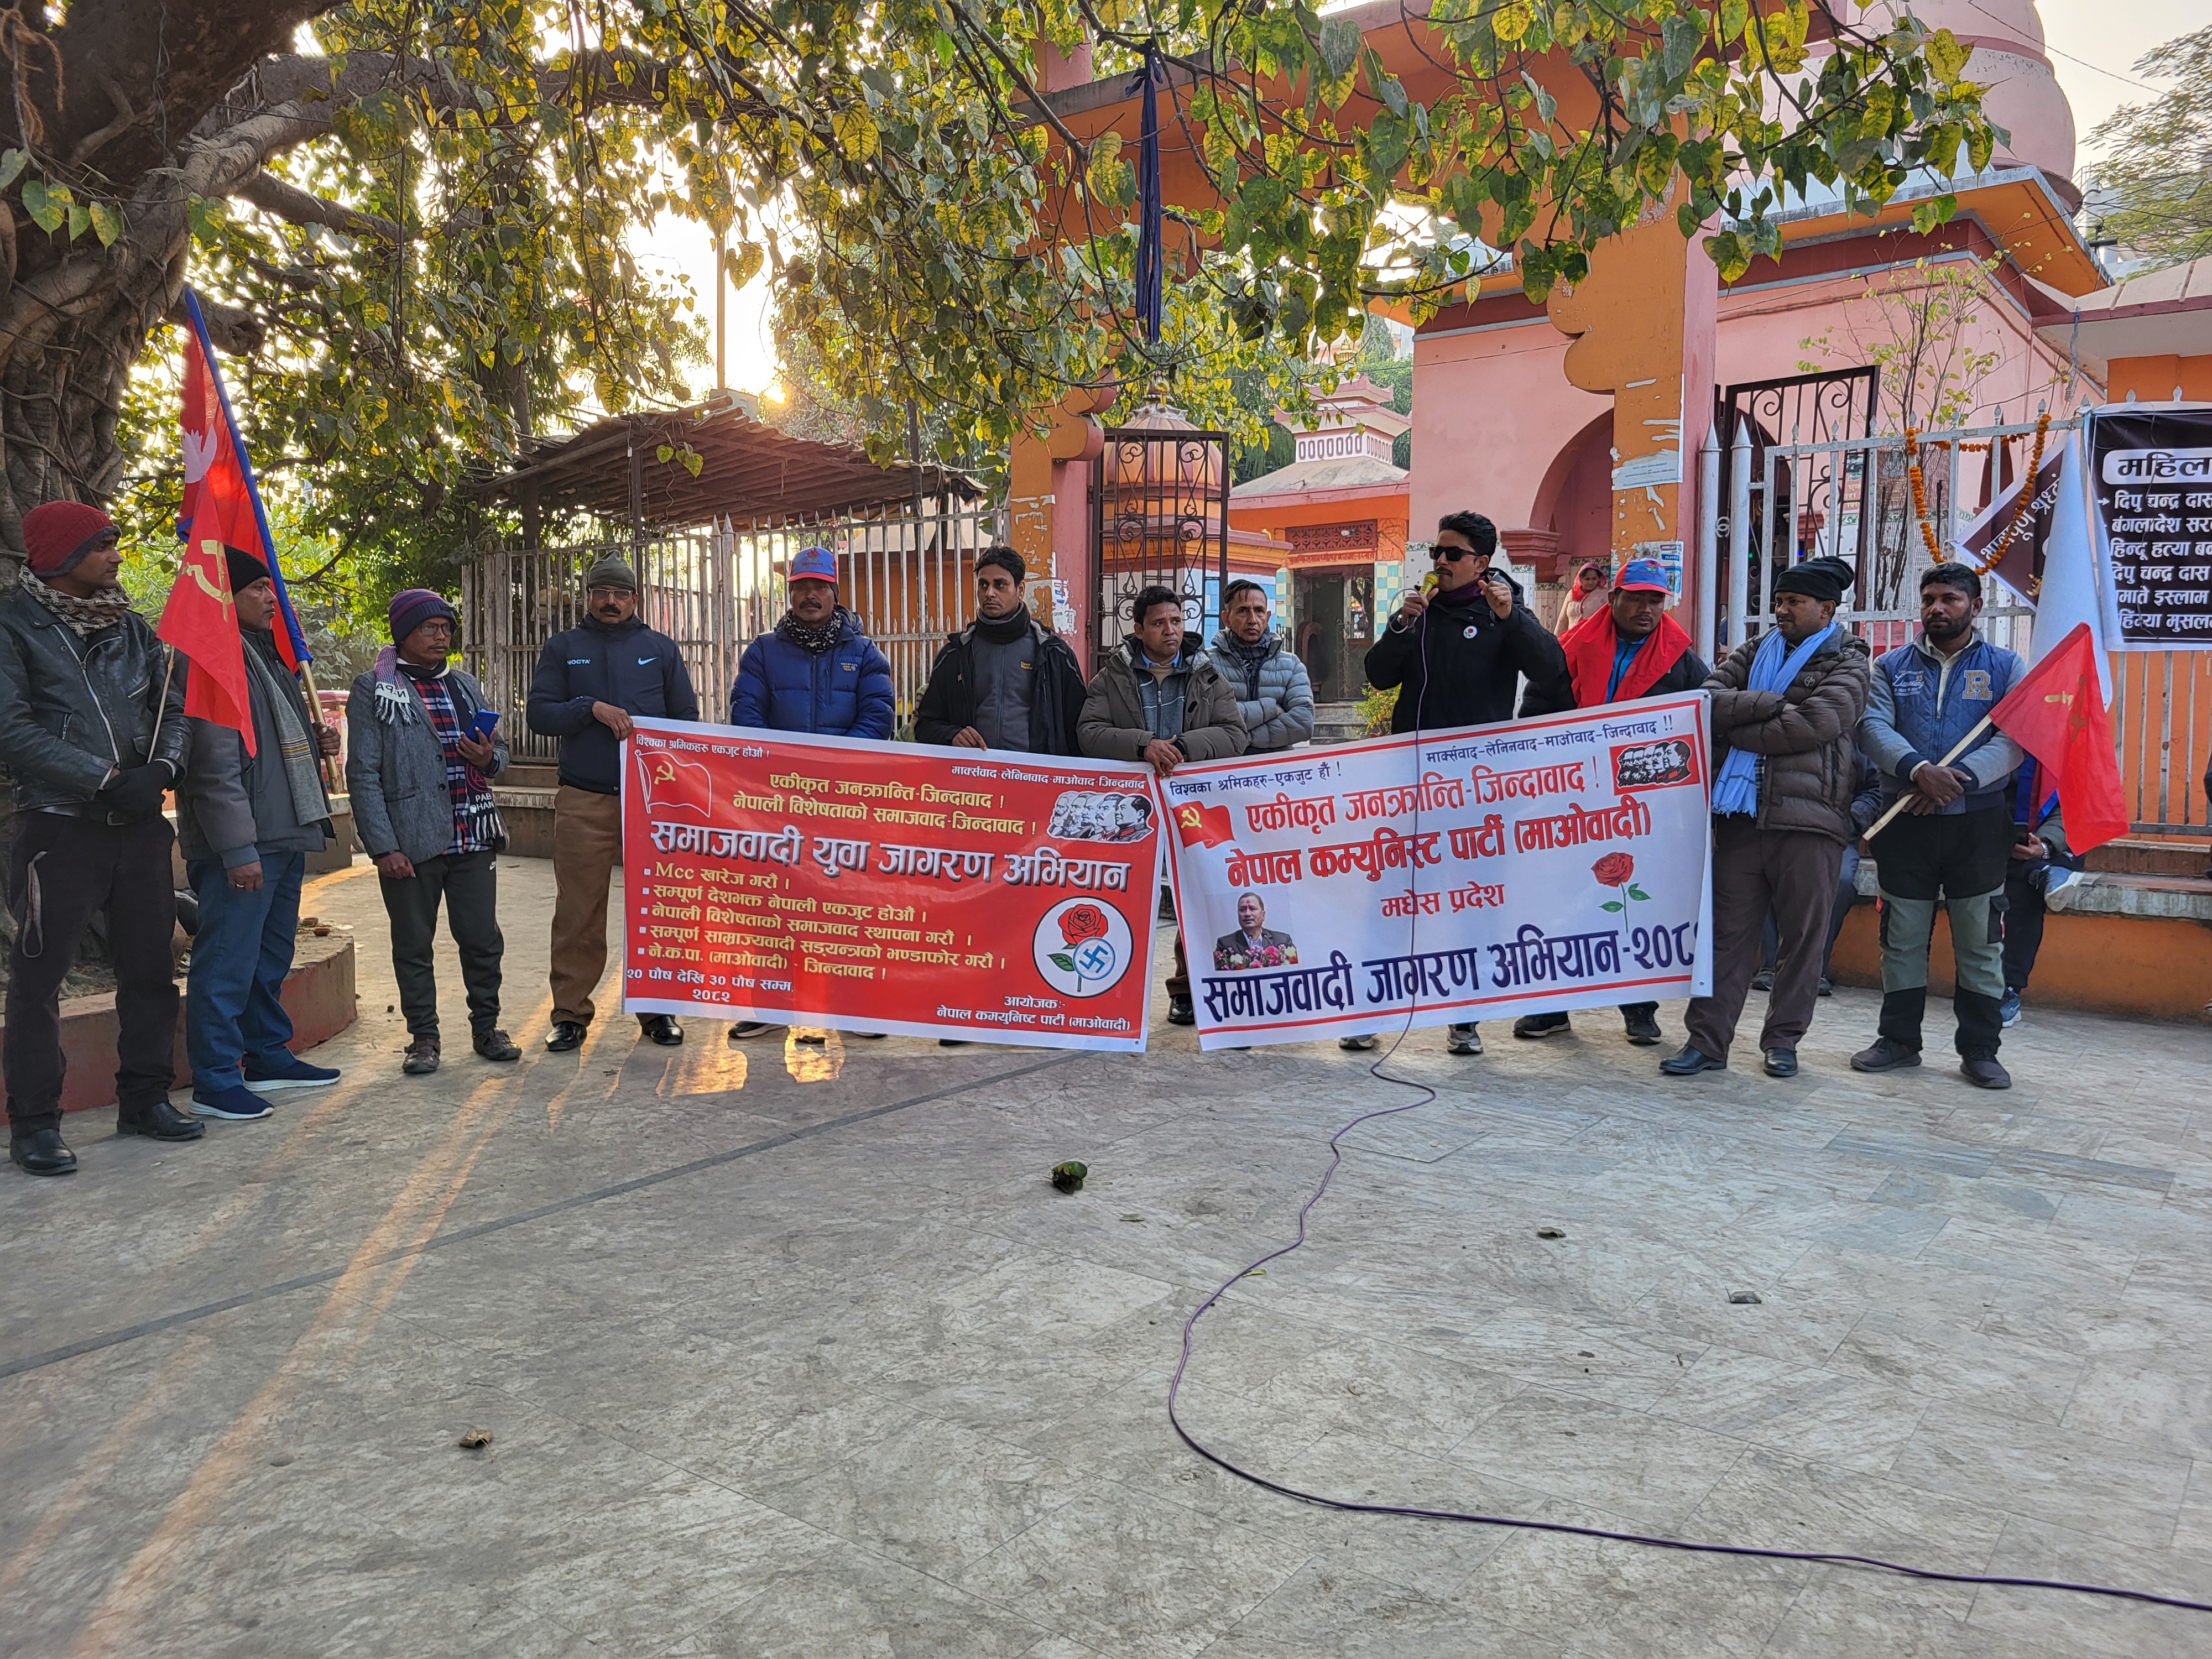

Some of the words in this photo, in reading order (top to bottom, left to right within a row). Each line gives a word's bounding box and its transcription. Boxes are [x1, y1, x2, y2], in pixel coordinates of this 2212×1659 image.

[2114, 489, 2143, 513] दिपु
[2146, 493, 2181, 510] चन्द्र
[2111, 513, 2182, 533] बंगलादेश
[2185, 518, 2212, 533] सर
[2151, 542, 2191, 558] हत्या
[2140, 566, 2174, 582] चन्द्र
[2178, 566, 2211, 581] दास
[2154, 590, 2210, 607] इस्लाम
[2166, 614, 2212, 633] मुसल
[1962, 670, 1992, 700] R
[636, 734, 667, 748] विश्वका
[711, 744, 740, 758] एकजुट
[769, 772, 831, 795] एकीकृत
[1168, 781, 1212, 796] विश्वका
[733, 790, 785, 812] नेपाली
[789, 795, 869, 820] विशेषताको
[1245, 792, 1337, 837] एकीकृत
[1225, 848, 1303, 889] नेपाल
[1309, 827, 1442, 883] कम्युनिस्ट
[1448, 813, 1505, 860] पार्टी
[1514, 794, 1651, 854] (माओवादी)
[650, 821, 805, 866] समाजवादी
[812, 837, 872, 879] युवा
[878, 842, 996, 883] जागरण
[1002, 846, 1132, 893] अभियान
[654, 861, 695, 880] Mcc
[700, 868, 745, 885] खारेज
[653, 884, 703, 904] सम्पूर्ण
[707, 886, 764, 907] देशभक्त
[768, 893, 818, 913] नेपाली
[822, 902, 874, 921] एकजुट
[1380, 889, 1441, 918] मधेस
[1448, 880, 1505, 913] प्रदेश
[651, 901, 702, 921] नेपाली
[706, 906, 783, 930] विशेषताको
[787, 918, 860, 938] समाजवाद
[864, 926, 921, 943] स्थापना
[650, 925, 700, 943] सम्पूर्ण
[704, 929, 796, 952] साम्राज्यवादी
[886, 949, 961, 967] भण्डाफोर
[626, 969, 643, 979] २०
[648, 966, 672, 982] पौष
[676, 969, 706, 984] देखि
[709, 975, 726, 985] ३०
[731, 974, 757, 988] पौष
[709, 951, 788, 970] (माओवादी)
[804, 958, 875, 980] जिन्दावाद
[692, 989, 731, 1003] २०८२
[1201, 950, 1354, 1022] समाजवादी
[1361, 946, 1480, 1004] जागरण
[936, 1004, 972, 1020] नेपाल
[1040, 1014, 1066, 1026] पार्टी
[1069, 1015, 1131, 1031] (माओवादी)
